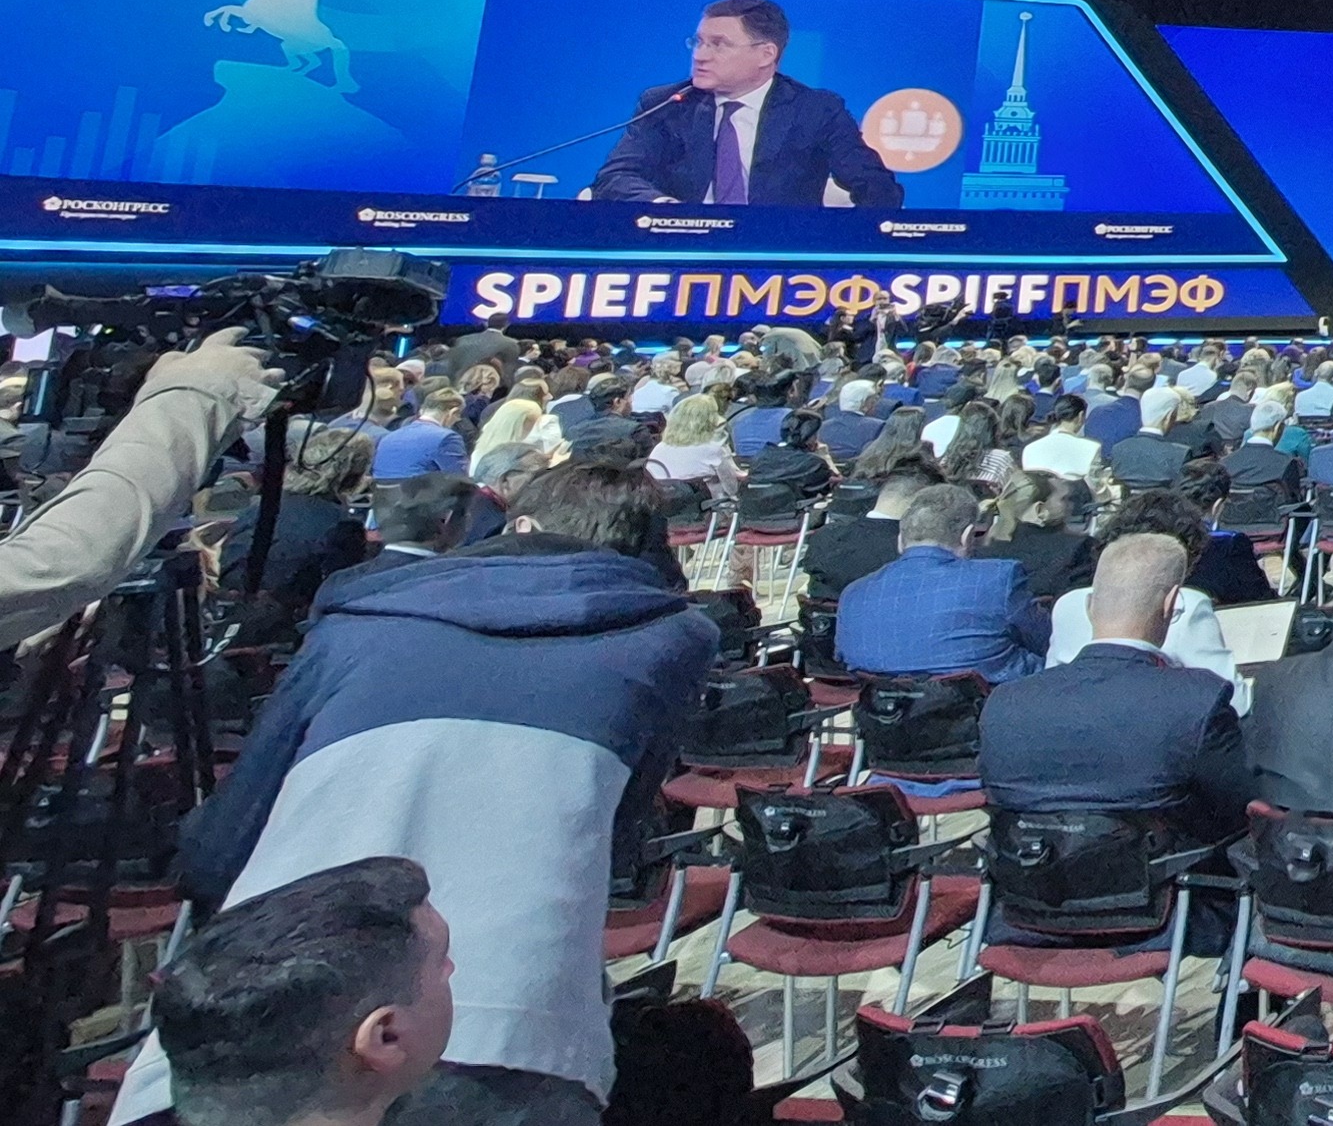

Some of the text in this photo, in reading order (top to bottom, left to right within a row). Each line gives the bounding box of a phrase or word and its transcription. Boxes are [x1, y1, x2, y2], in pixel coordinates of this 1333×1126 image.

[62, 199, 170, 213] РОСКОНГРЕСС
[375, 211, 470, 222] ROSCONGRESS
[472, 272, 671, 319] SPIEF
[674, 273, 882, 316] ПМЭФ
[1052, 273, 1225, 314] ПМЭФ
